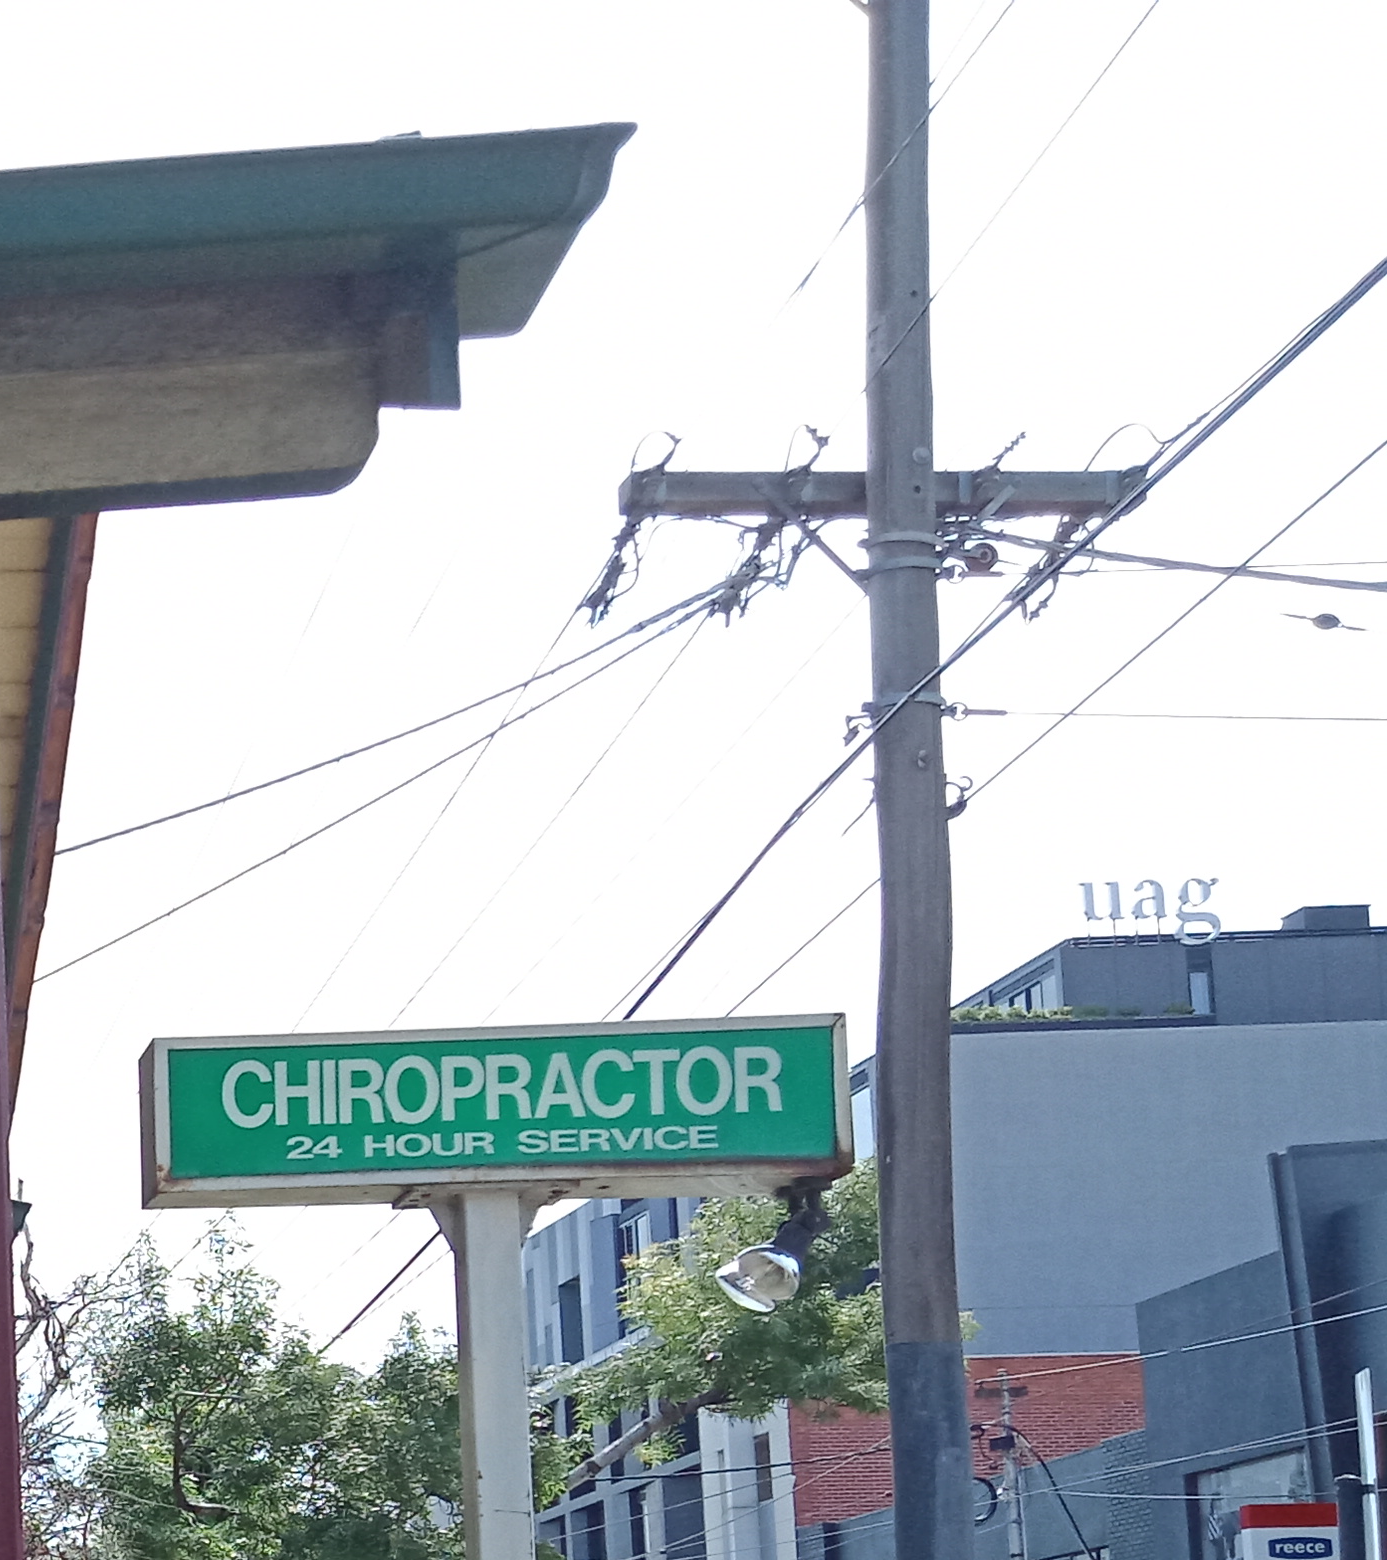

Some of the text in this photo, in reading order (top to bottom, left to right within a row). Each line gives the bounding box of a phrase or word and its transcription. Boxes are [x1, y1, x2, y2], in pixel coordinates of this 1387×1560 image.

[1078, 878, 1221, 945] uag
[221, 1045, 783, 1129] CHIROPRACTOR
[286, 1125, 719, 1160] 24 HOUR SERVICE
[1275, 1541, 1326, 1554] reece
